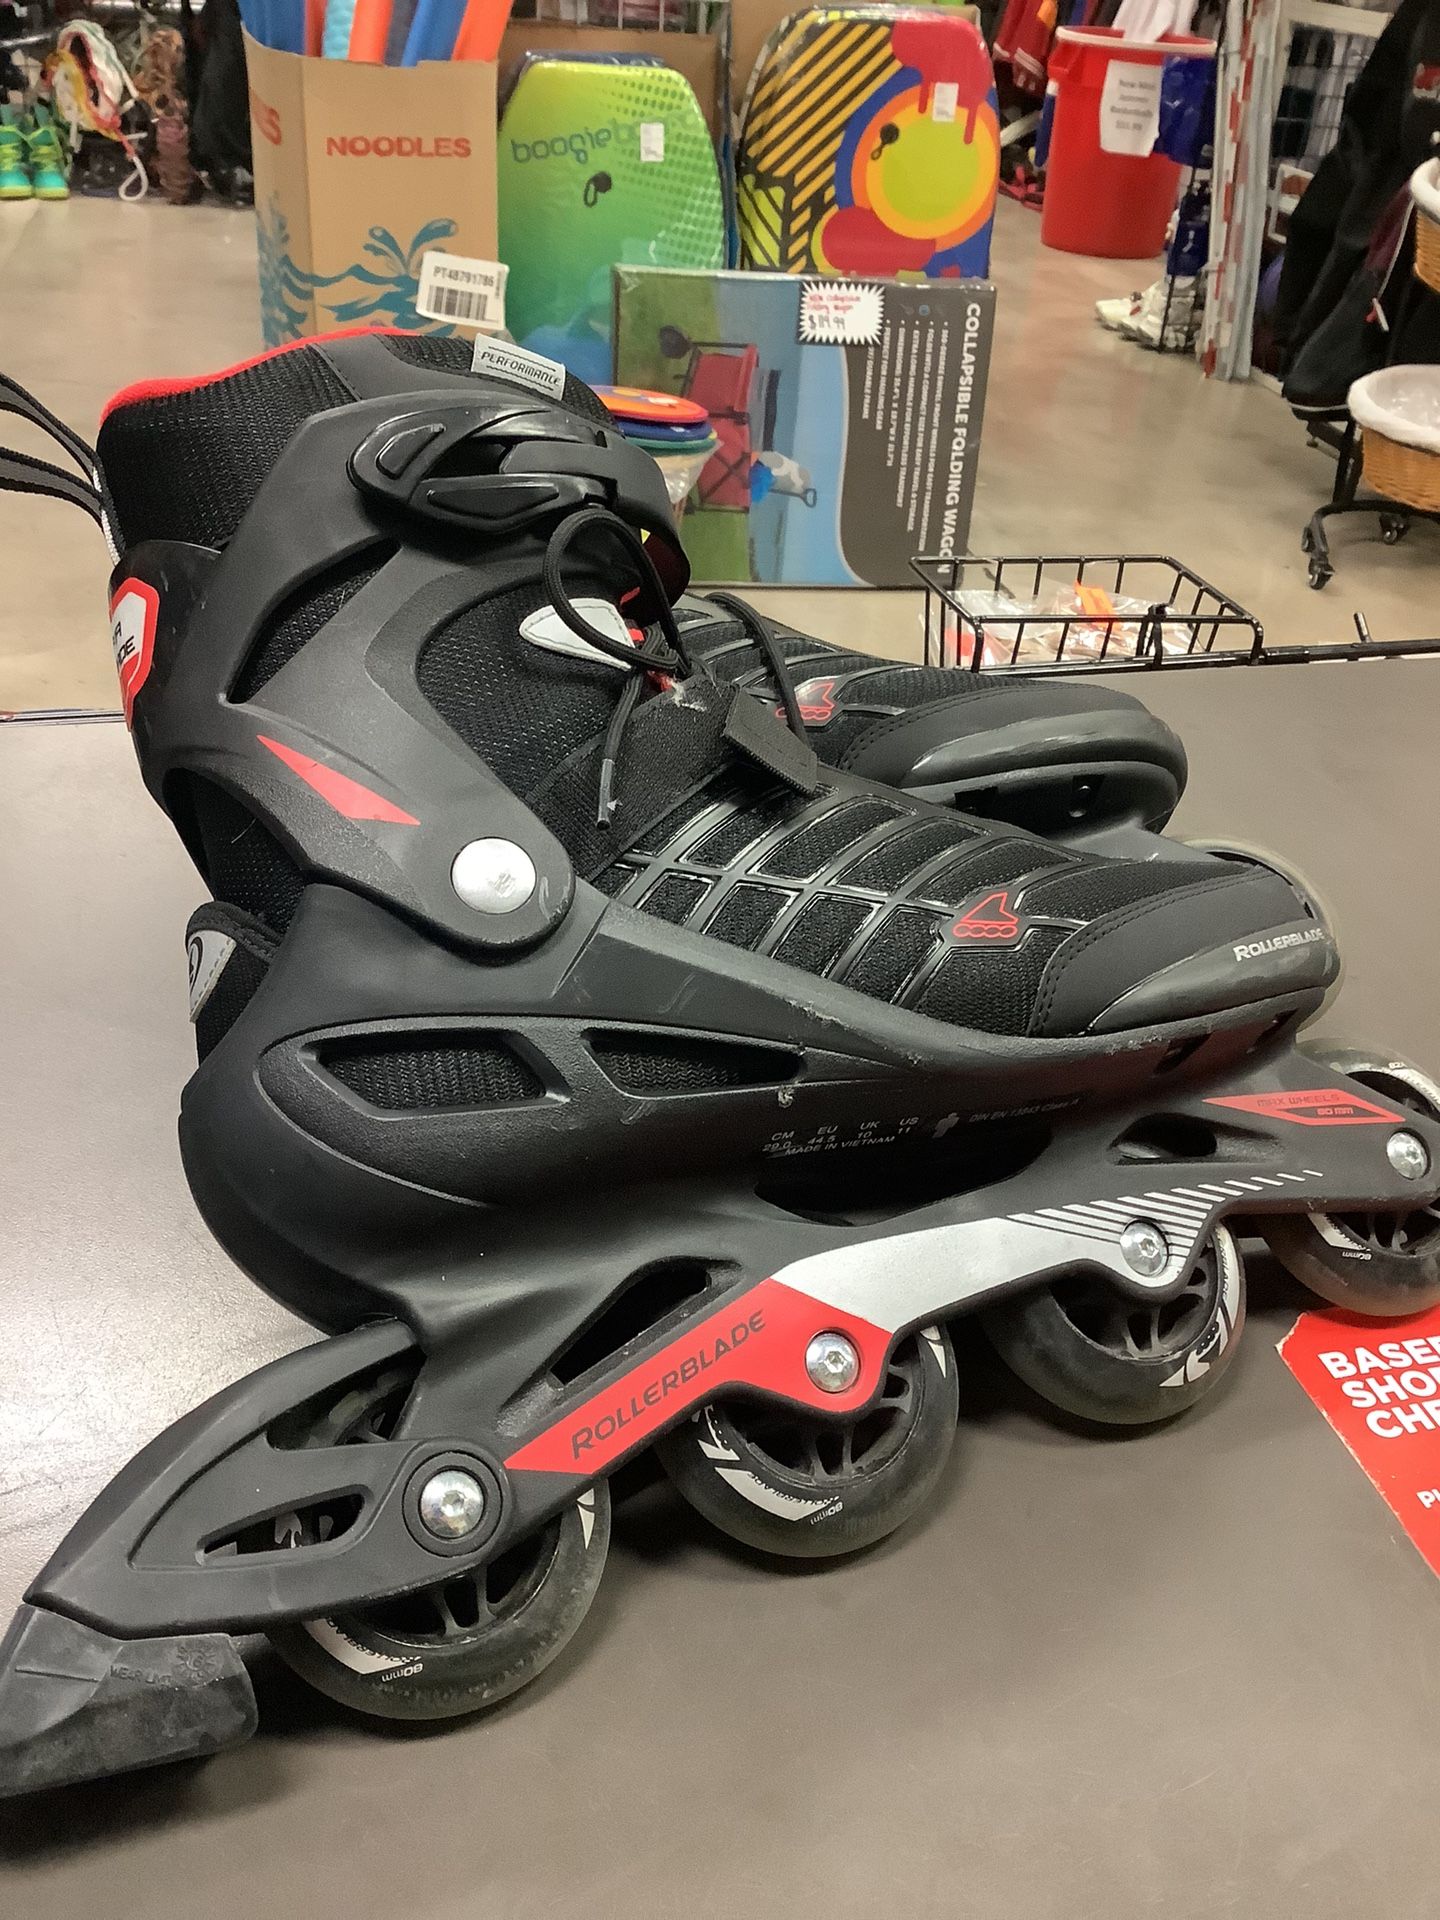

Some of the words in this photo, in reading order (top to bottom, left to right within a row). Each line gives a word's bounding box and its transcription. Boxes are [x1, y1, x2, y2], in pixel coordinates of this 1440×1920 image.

[326, 136, 471, 158] NOODLES
[481, 351, 561, 386] PERFORMANCE
[954, 302, 981, 424] COLLAPSIBLE
[945, 426, 967, 506] FOLDING
[1288, 1094, 1340, 1105] WHEELS
[771, 1131, 795, 1141] CM
[817, 1125, 838, 1135] EU
[860, 1121, 881, 1130] UK
[899, 1117, 919, 1126] US
[858, 1131, 872, 1139] 10
[784, 1144, 821, 1156] MADE
[841, 1136, 895, 1149] VIETNAM
[570, 1308, 766, 1460] ROLLERBLADE
[381, 1663, 424, 1682] 80mm
